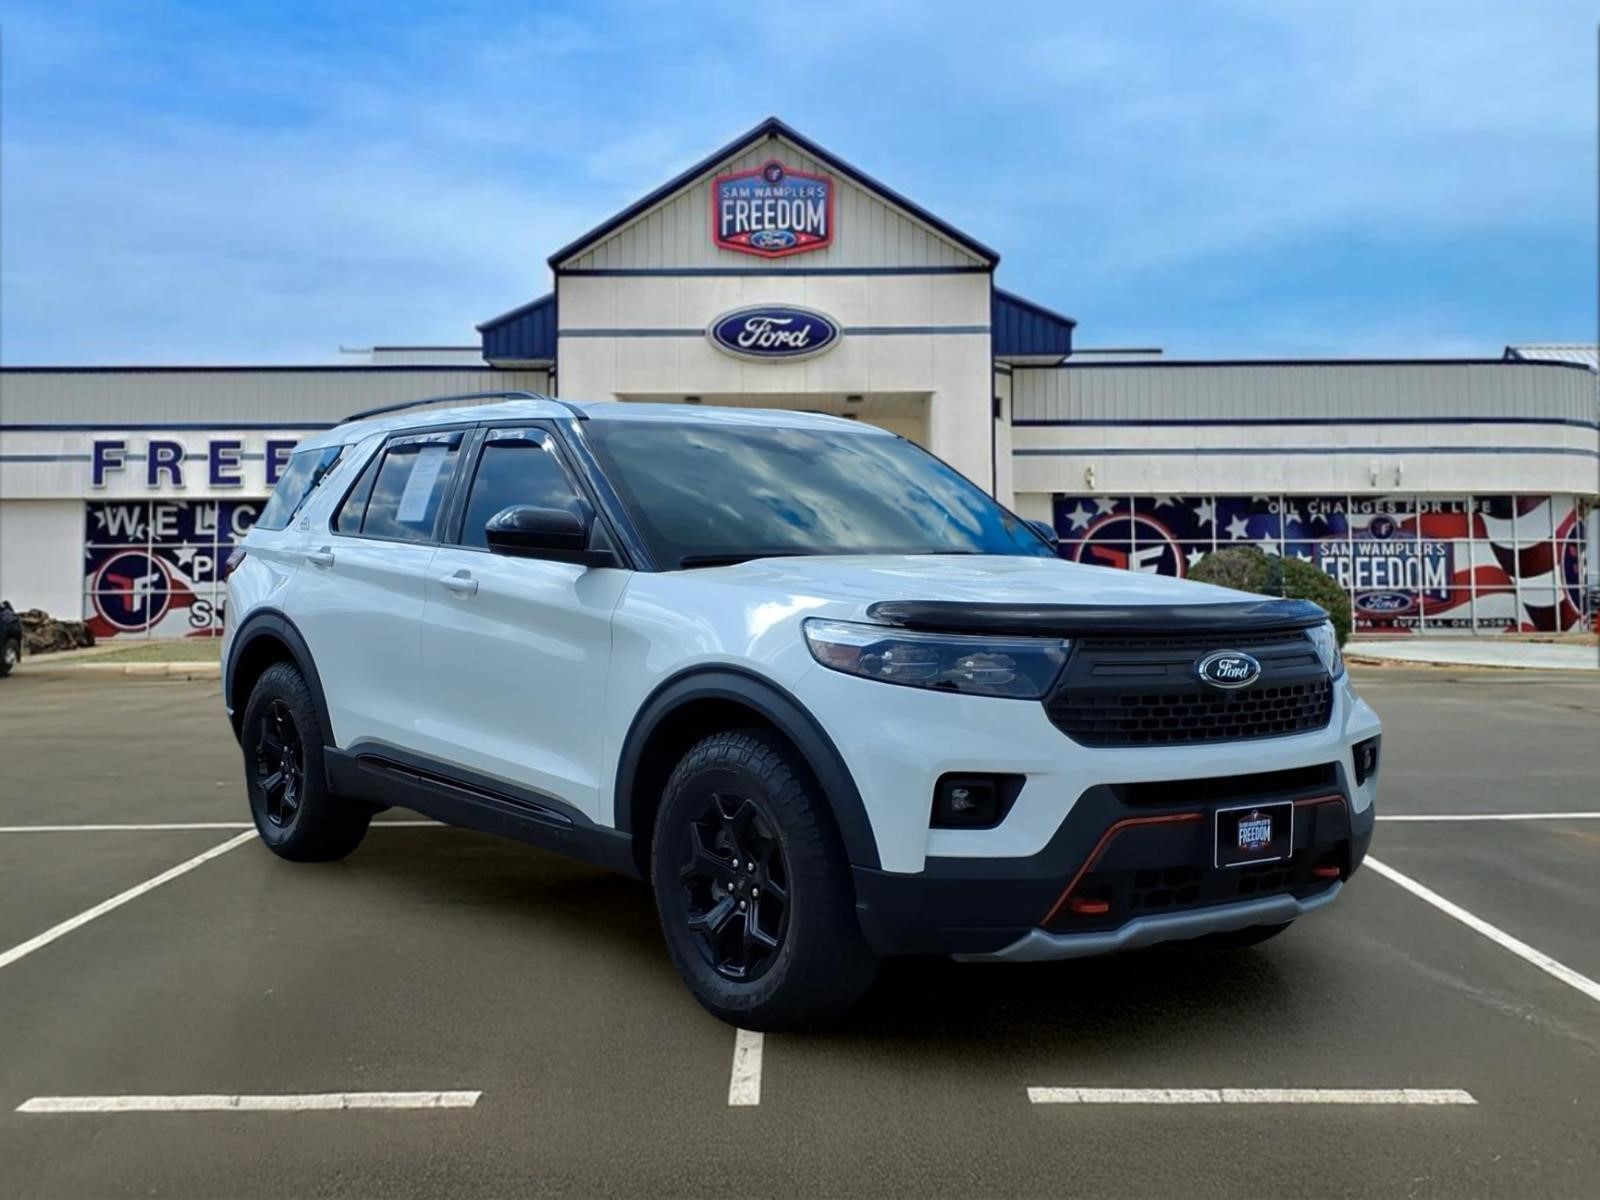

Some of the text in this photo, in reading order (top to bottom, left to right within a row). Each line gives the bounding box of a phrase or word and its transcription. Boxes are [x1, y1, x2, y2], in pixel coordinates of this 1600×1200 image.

[721, 187, 750, 198] SAM
[721, 199, 825, 237] FREEDOM
[759, 232, 787, 247] Ford
[737, 316, 812, 347] Ford
[1268, 500, 1491, 514] OIL CHANGES FOR LIFE
[1320, 556, 1448, 599] FREEDOM
[1365, 595, 1401, 609] Ford
[1216, 659, 1249, 678] Ford
[1238, 824, 1271, 846] FREEDOM
